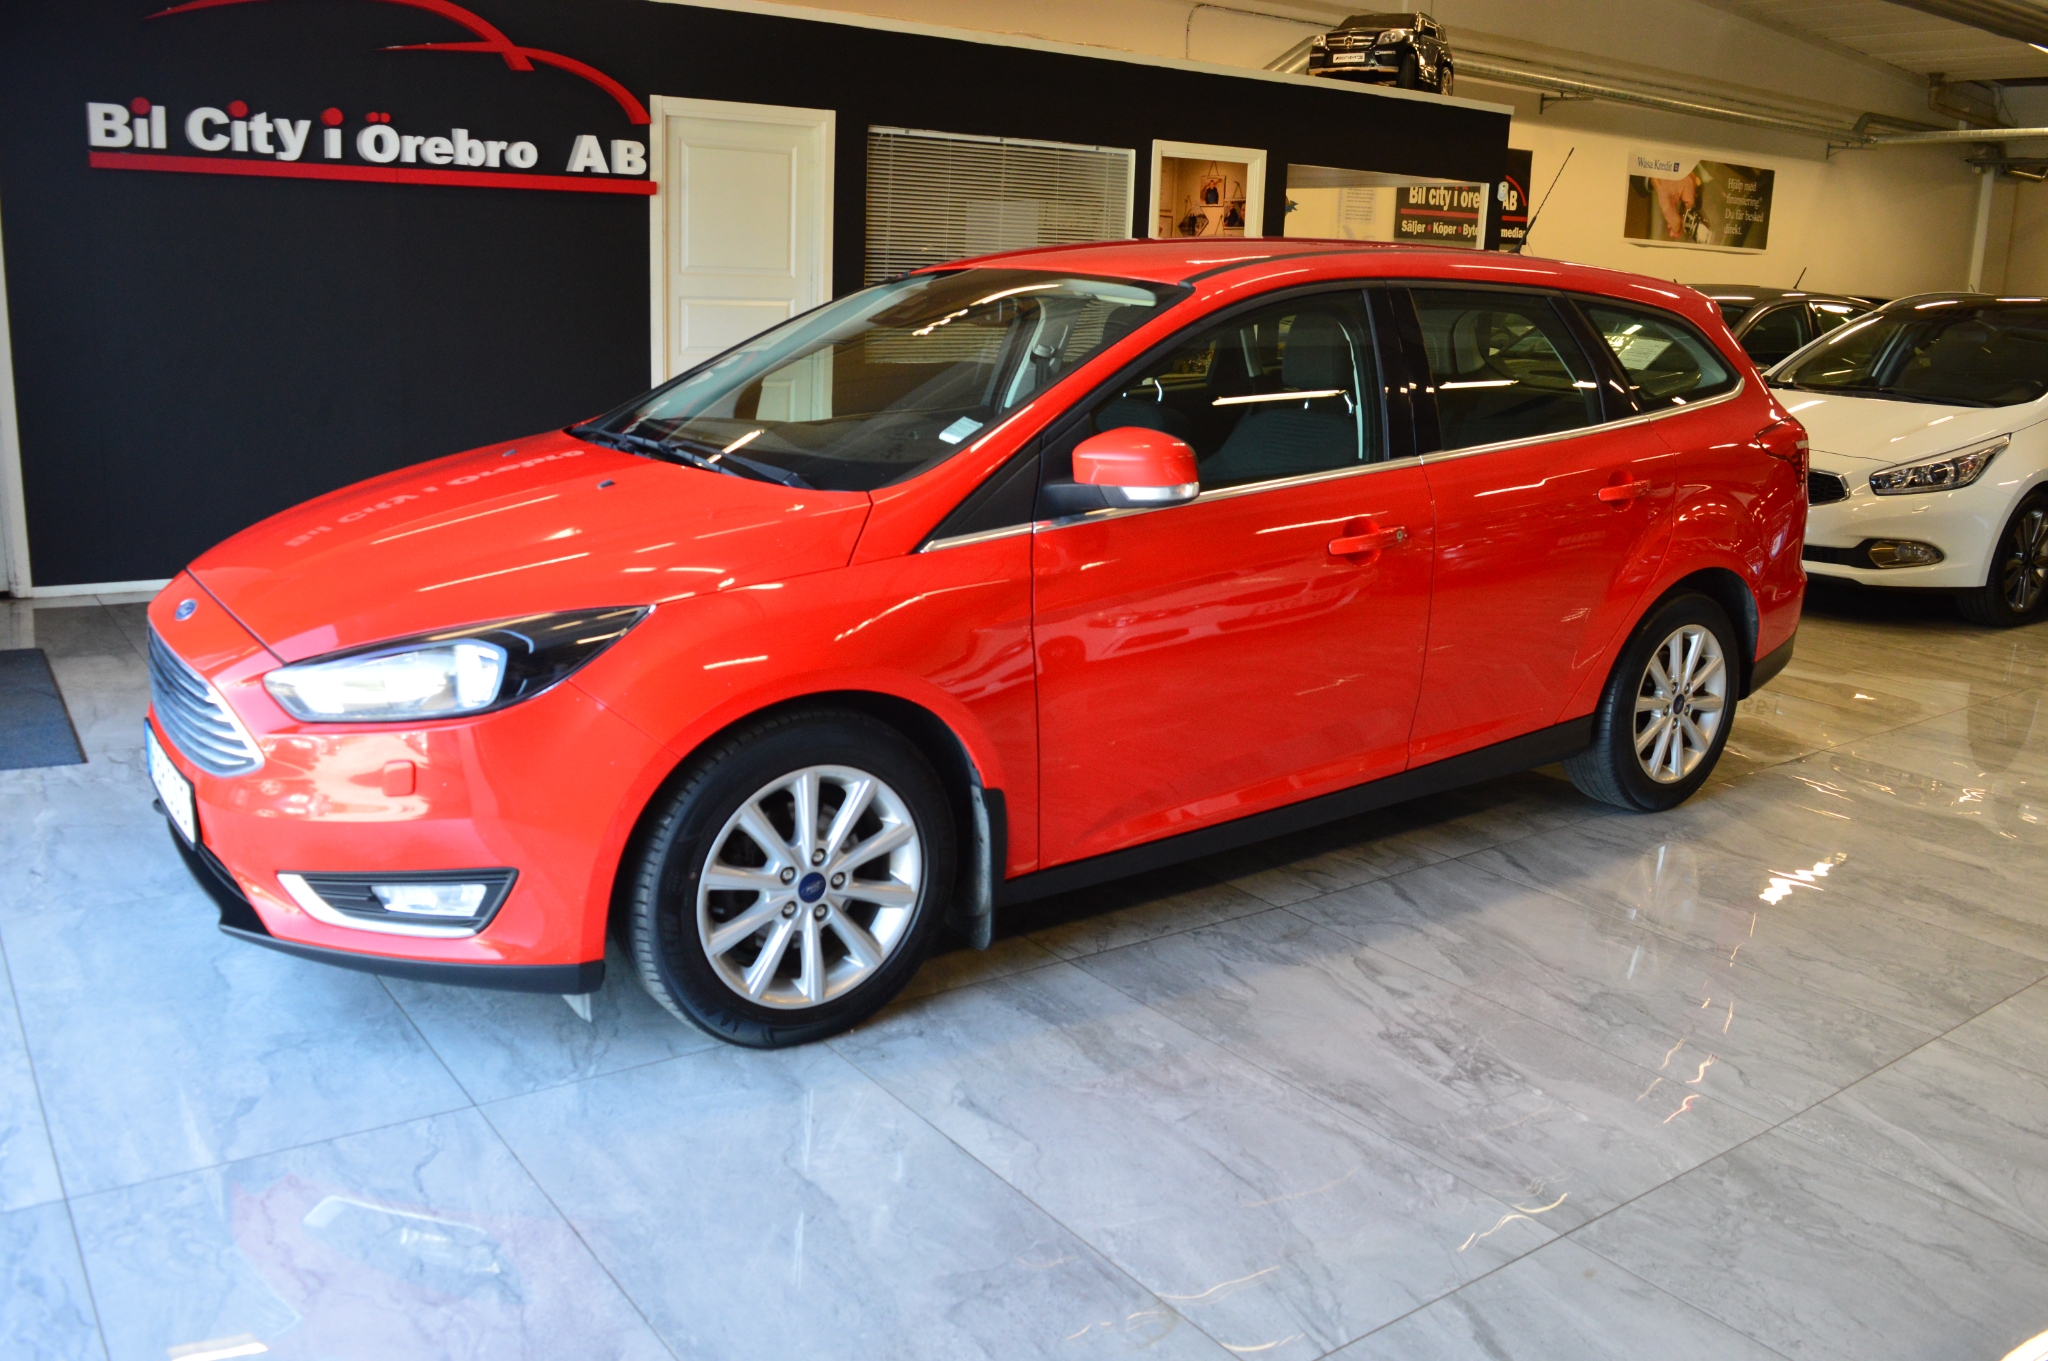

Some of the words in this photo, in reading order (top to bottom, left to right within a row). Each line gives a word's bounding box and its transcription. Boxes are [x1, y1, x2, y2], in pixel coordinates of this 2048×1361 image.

[86, 97, 167, 149] Bil
[184, 100, 311, 161] City
[320, 107, 344, 159] i
[356, 111, 538, 169] Örebro
[565, 134, 648, 175] AB
[1637, 157, 1653, 169] Wasa
[1654, 160, 1672, 171] Kredit
[1744, 182, 1756, 191] med
[1409, 187, 1426, 205] Bil
[1429, 186, 1452, 211] city
[1454, 186, 1458, 206] i
[1460, 186, 1480, 208] öre
[1725, 209, 1734, 219] Du
[1745, 211, 1764, 222] besked
[1401, 220, 1425, 235] Säljer
[1433, 222, 1457, 236] Köper
